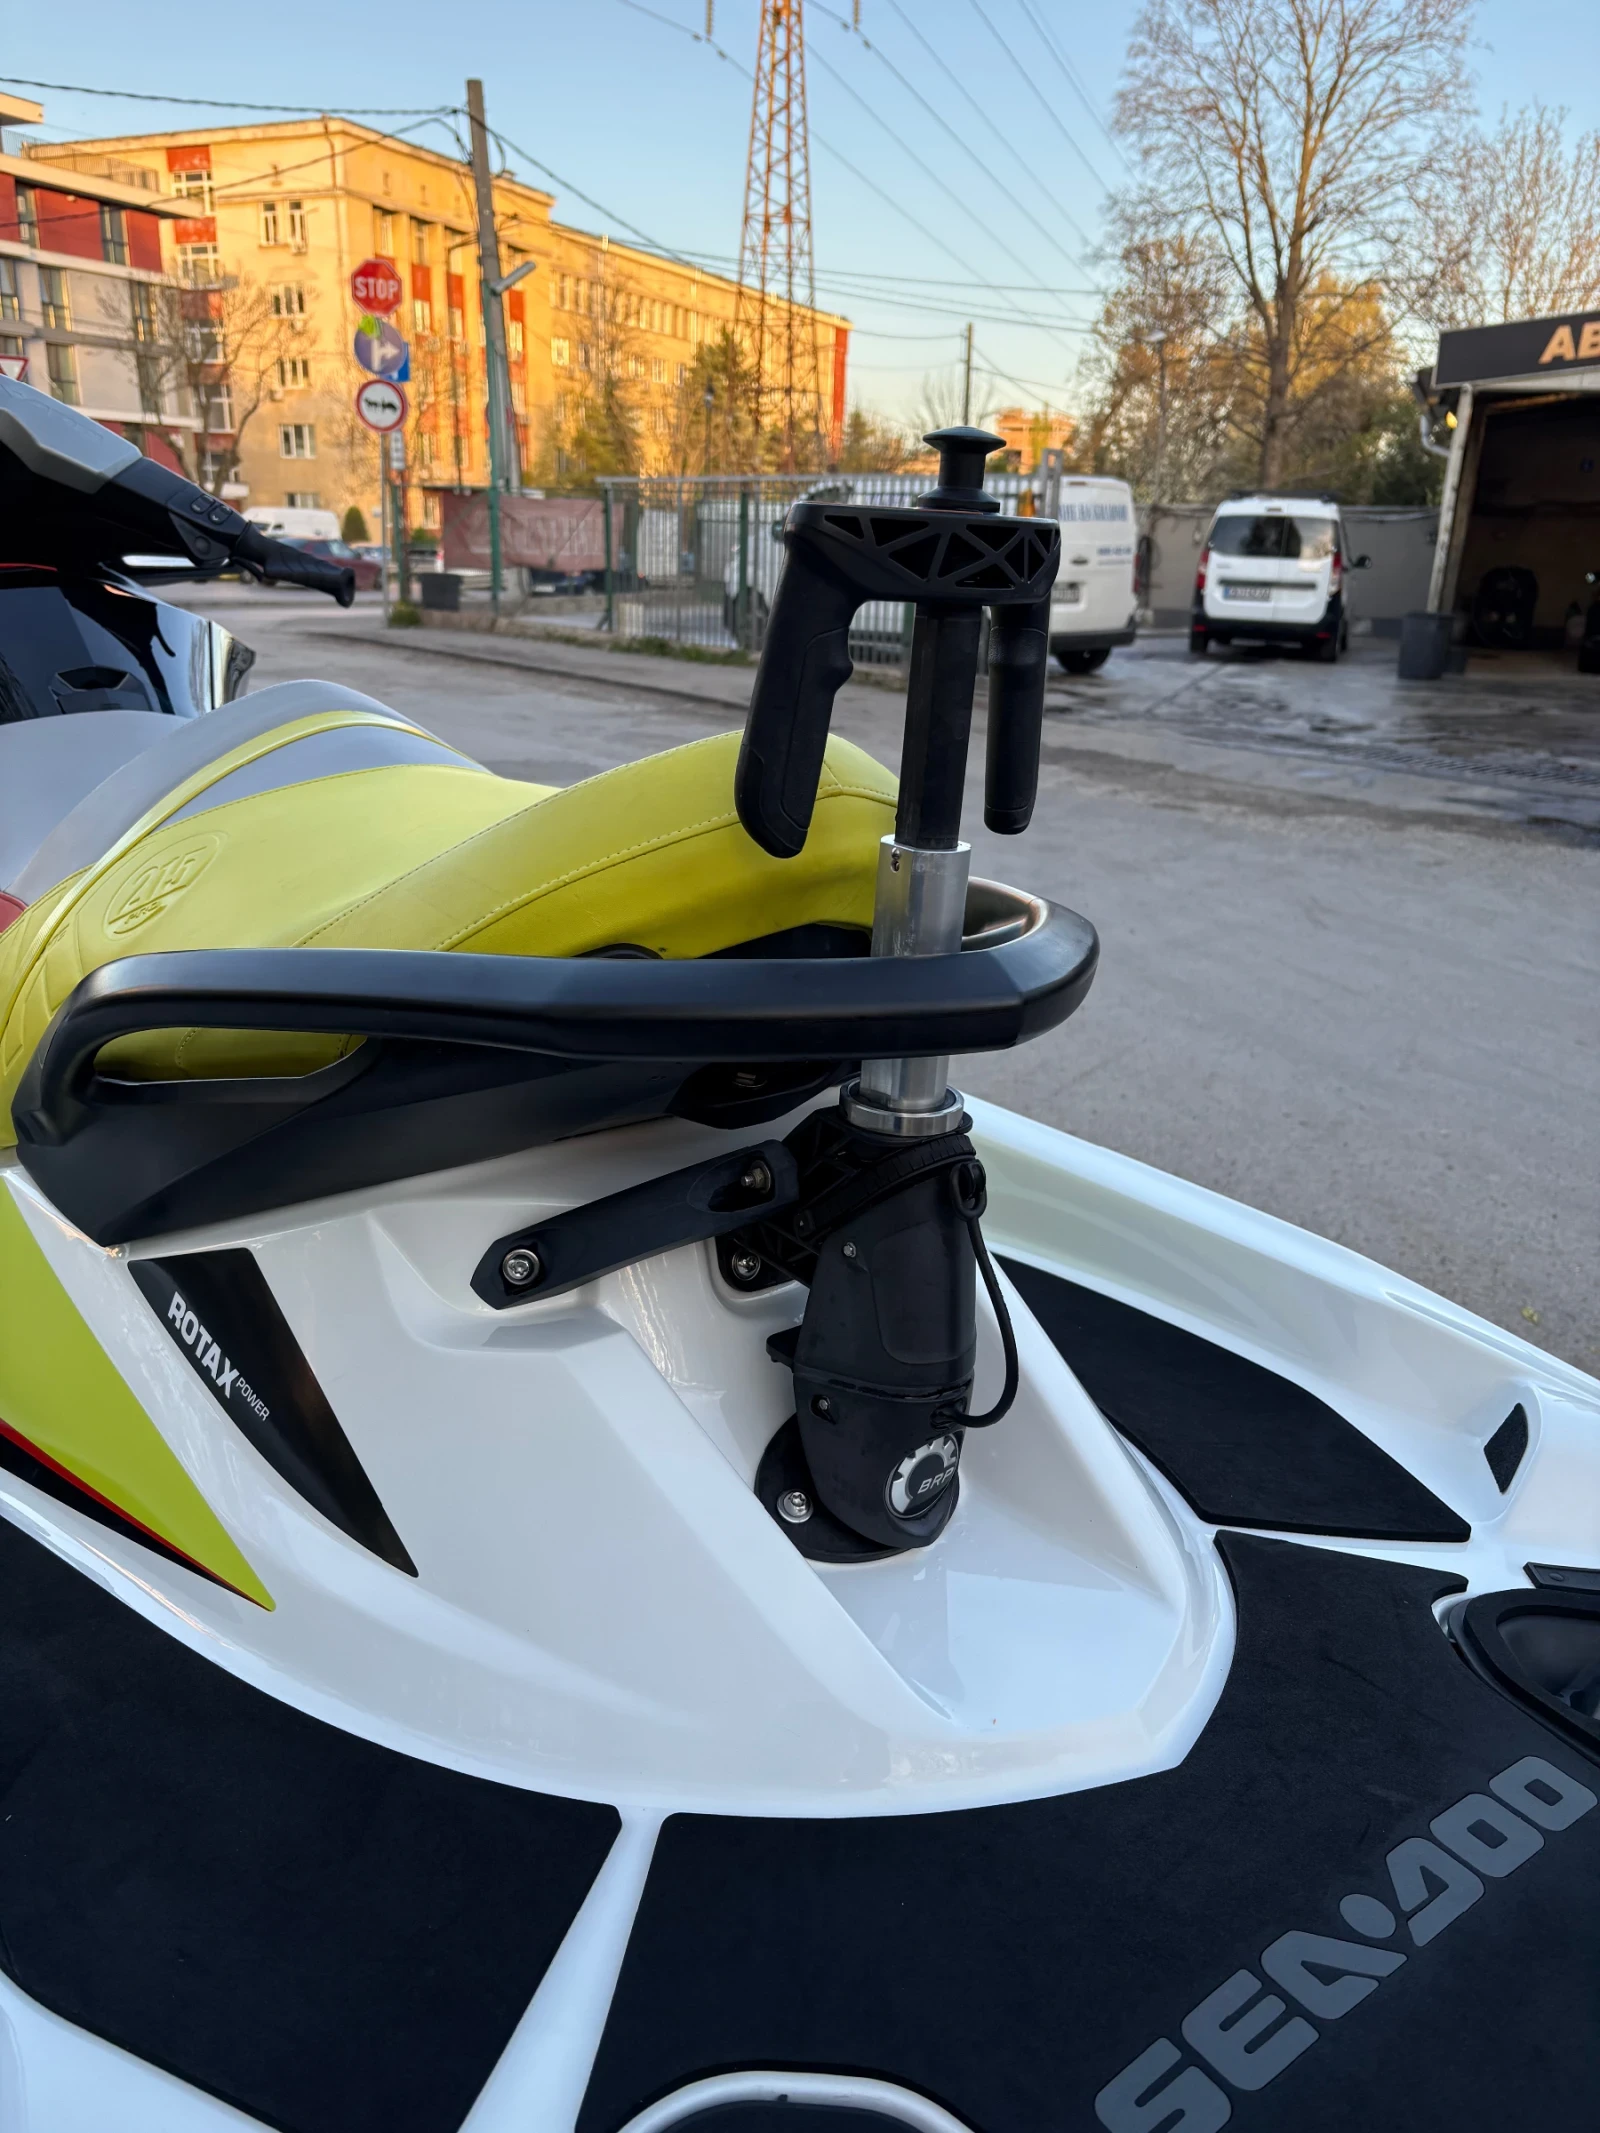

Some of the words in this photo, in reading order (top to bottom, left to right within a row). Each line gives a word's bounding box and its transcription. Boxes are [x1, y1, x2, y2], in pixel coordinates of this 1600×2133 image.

[354, 276, 398, 300] STOP
[168, 1291, 239, 1399] ROTAX
[235, 1377, 270, 1422] POWER
[917, 1466, 956, 1494] BRP
